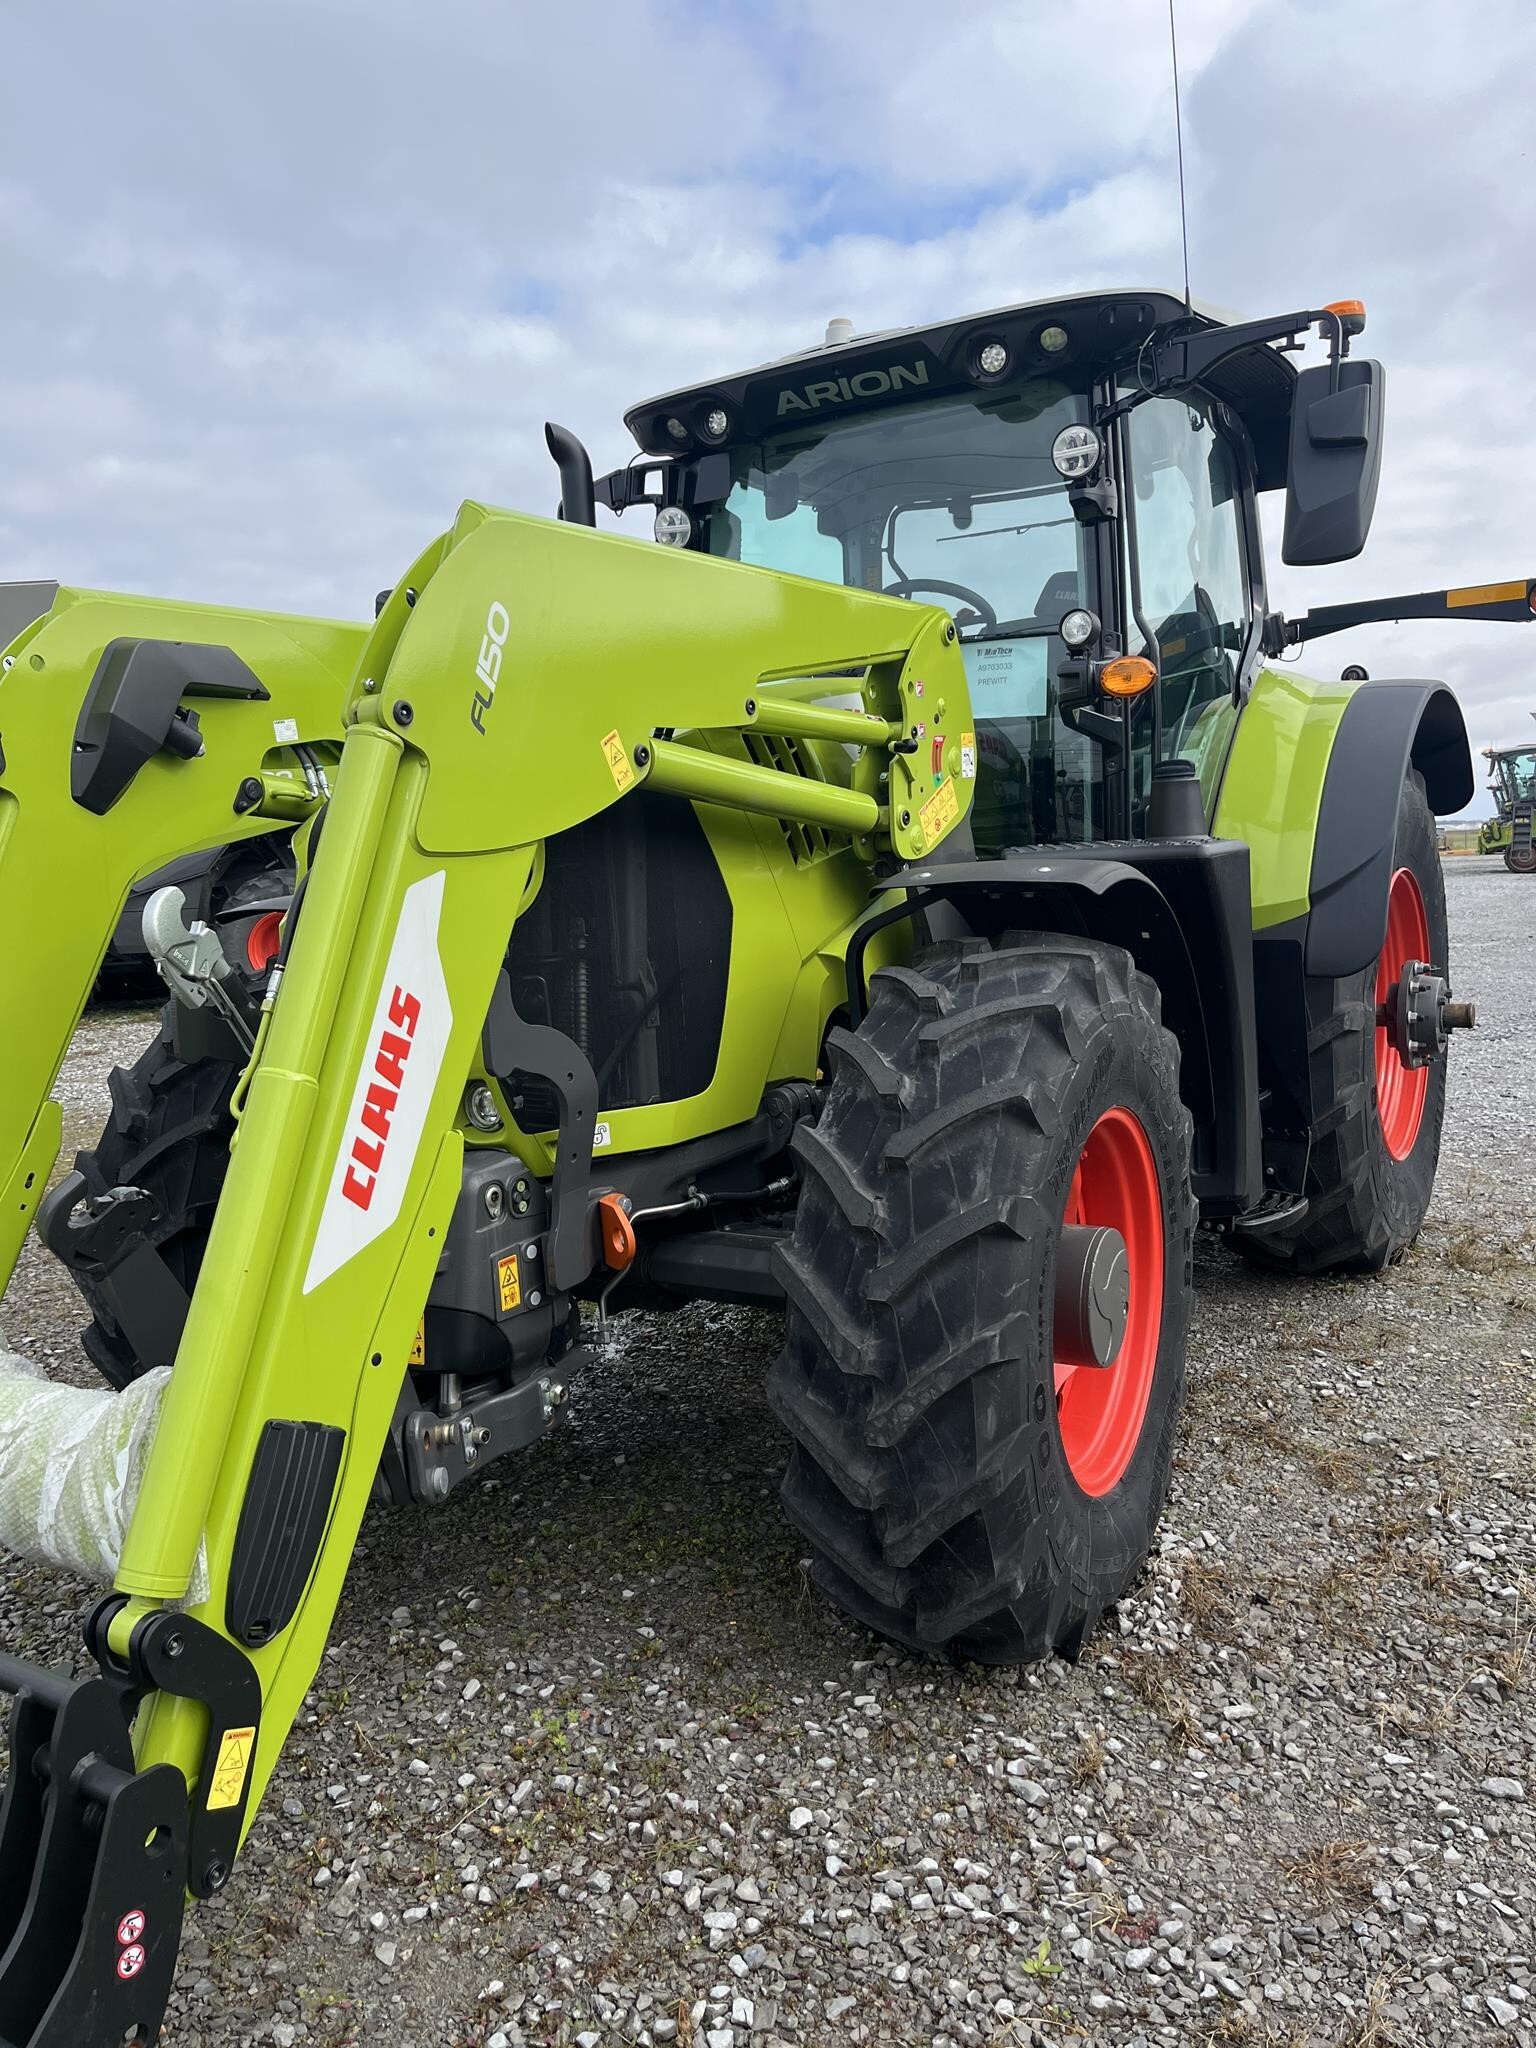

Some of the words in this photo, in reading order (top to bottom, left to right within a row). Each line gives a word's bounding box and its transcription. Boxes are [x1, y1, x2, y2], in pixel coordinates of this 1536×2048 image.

[776, 360, 929, 416] ARION
[977, 677, 1008, 686] PREWITT
[341, 984, 421, 1212] CLAAS
